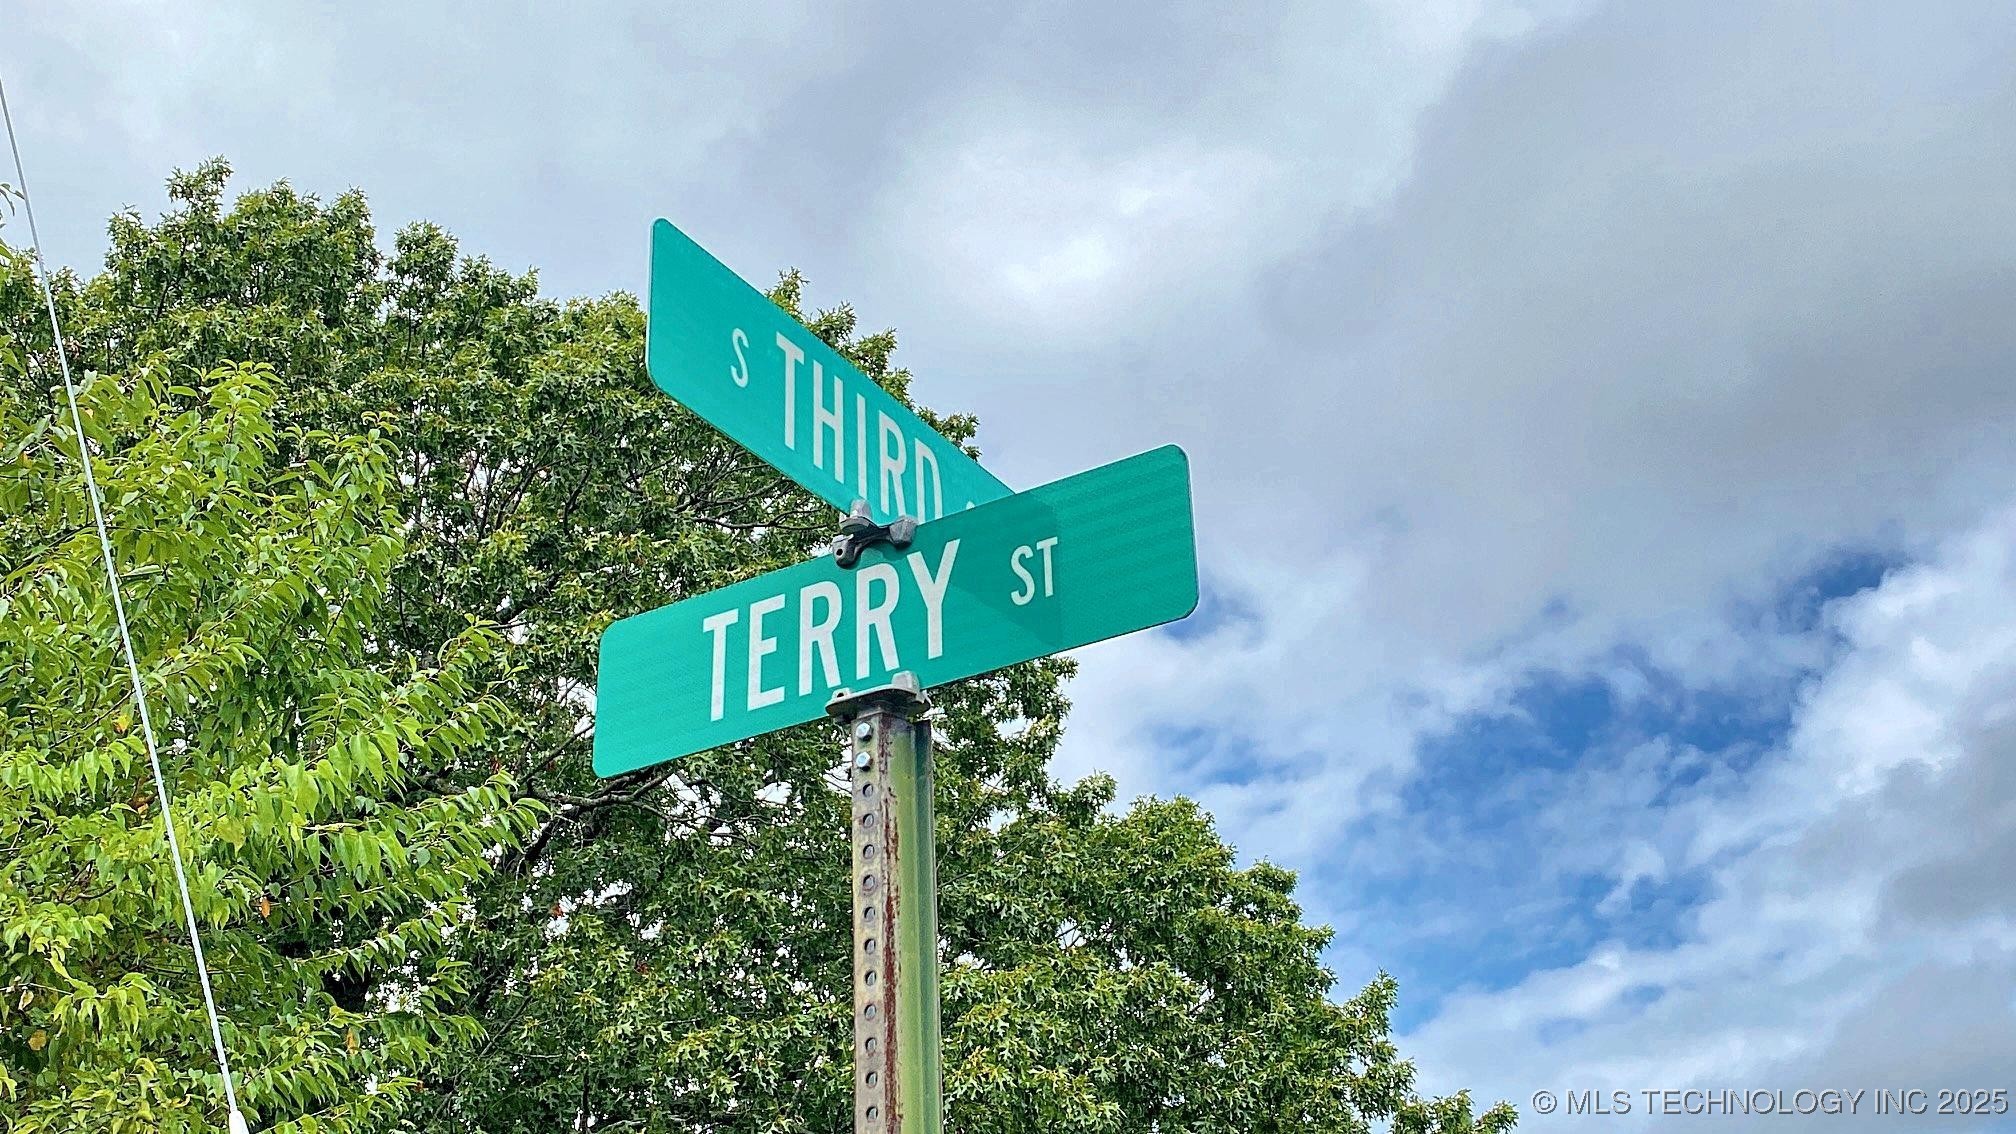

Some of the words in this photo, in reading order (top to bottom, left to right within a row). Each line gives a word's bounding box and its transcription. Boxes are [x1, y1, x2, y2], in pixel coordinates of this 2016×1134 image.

[730, 327, 750, 388] S
[776, 331, 943, 526] THIRD
[702, 538, 961, 722] TERRY
[1009, 536, 1059, 606] ST
